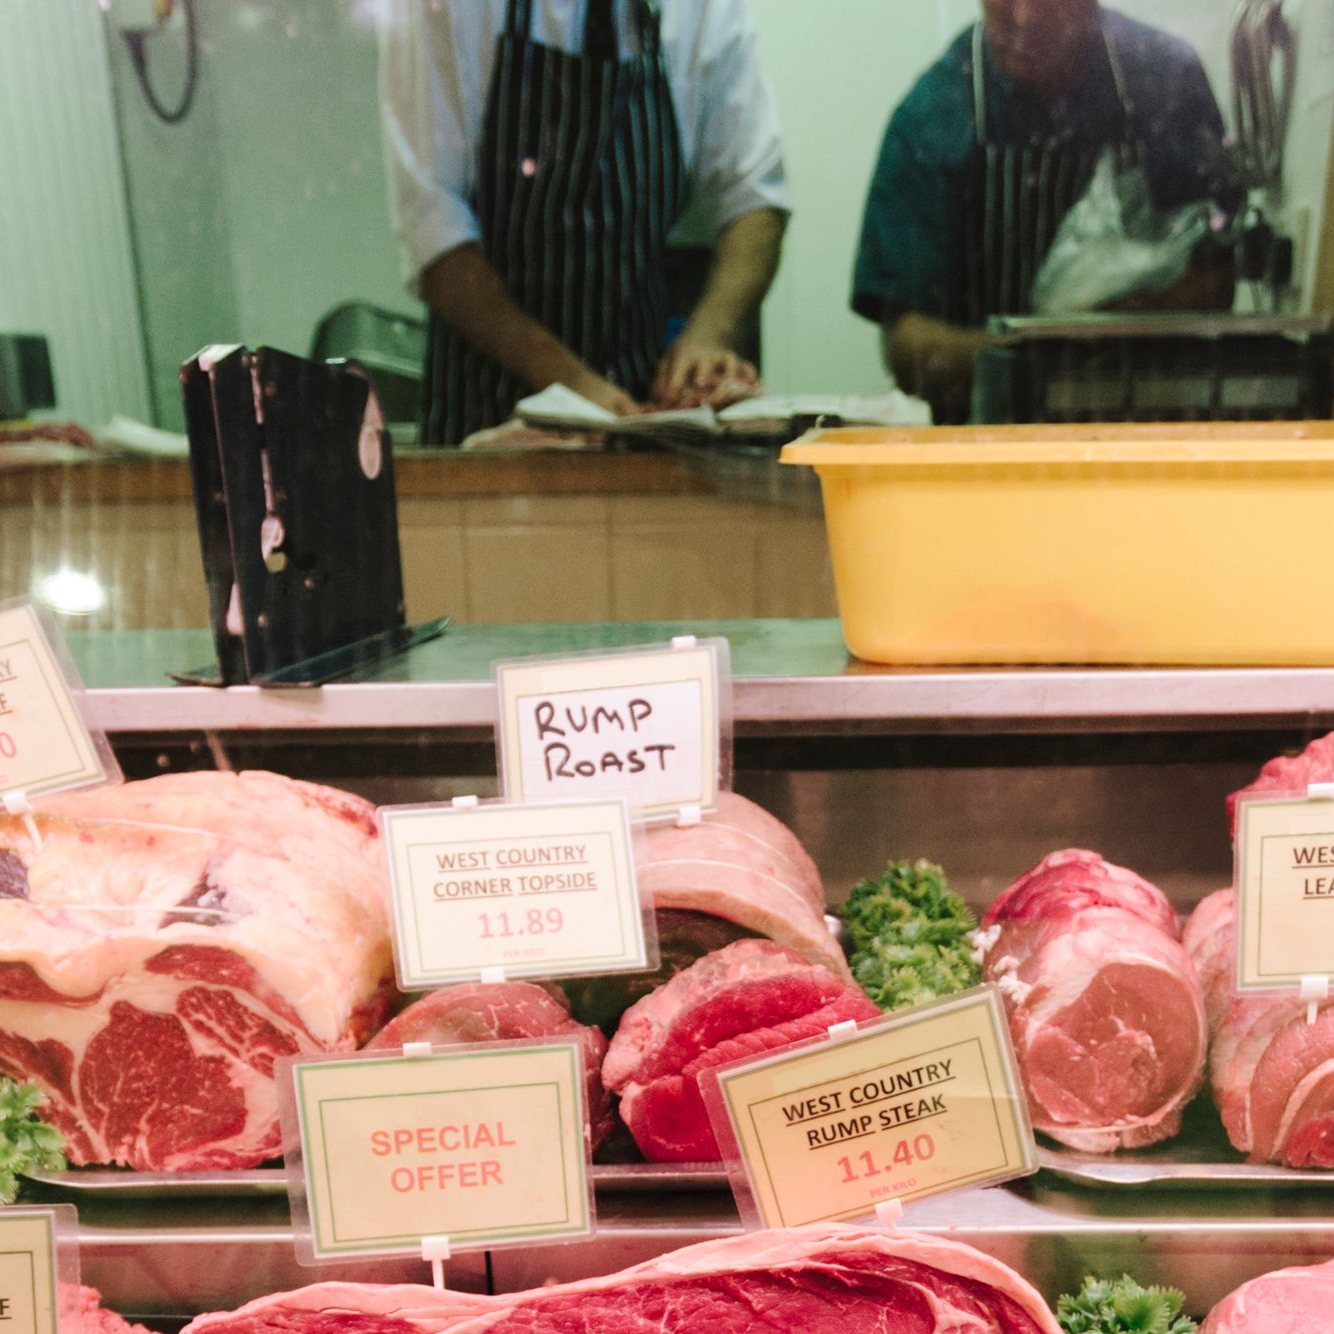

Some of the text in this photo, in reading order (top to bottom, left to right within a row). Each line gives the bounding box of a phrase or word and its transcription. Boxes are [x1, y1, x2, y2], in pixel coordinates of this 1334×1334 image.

[534, 699, 652, 740] RUMP
[544, 742, 675, 782] ROAST
[436, 845, 586, 869] WEST COUNTRY
[433, 872, 597, 897] CORNER TOPSIDE
[476, 907, 563, 939] 11.89
[782, 1058, 954, 1122] WEST COUNTRY
[806, 1094, 947, 1147] RUMP STEAK
[370, 1122, 516, 1157] SPECIAL
[837, 1132, 936, 1184] 11.40
[391, 1160, 504, 1193] OFFER
[870, 1178, 917, 1198] PER KILO
